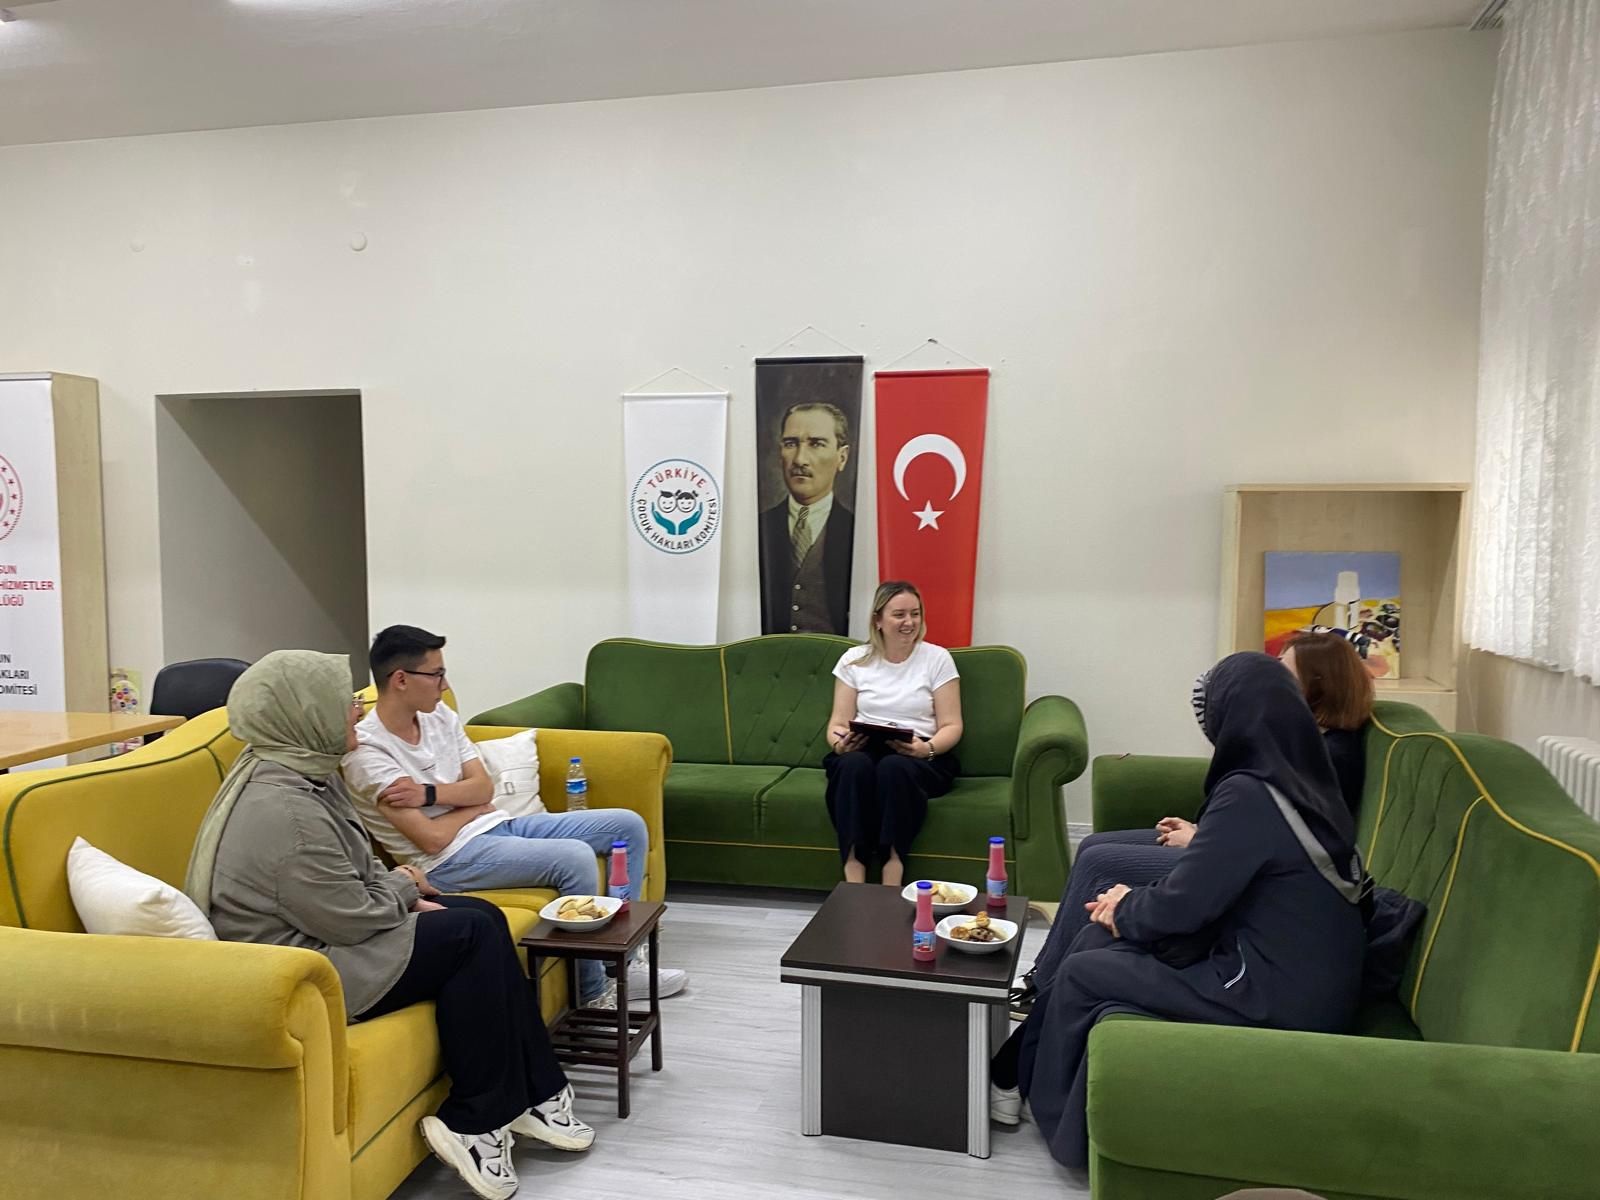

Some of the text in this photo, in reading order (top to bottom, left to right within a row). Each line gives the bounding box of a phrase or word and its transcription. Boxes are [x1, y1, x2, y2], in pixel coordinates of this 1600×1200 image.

[646, 467, 706, 489] TÜRKİYE
[636, 498, 717, 550] ÇOCUK HAKLARI KOMİTESİ
